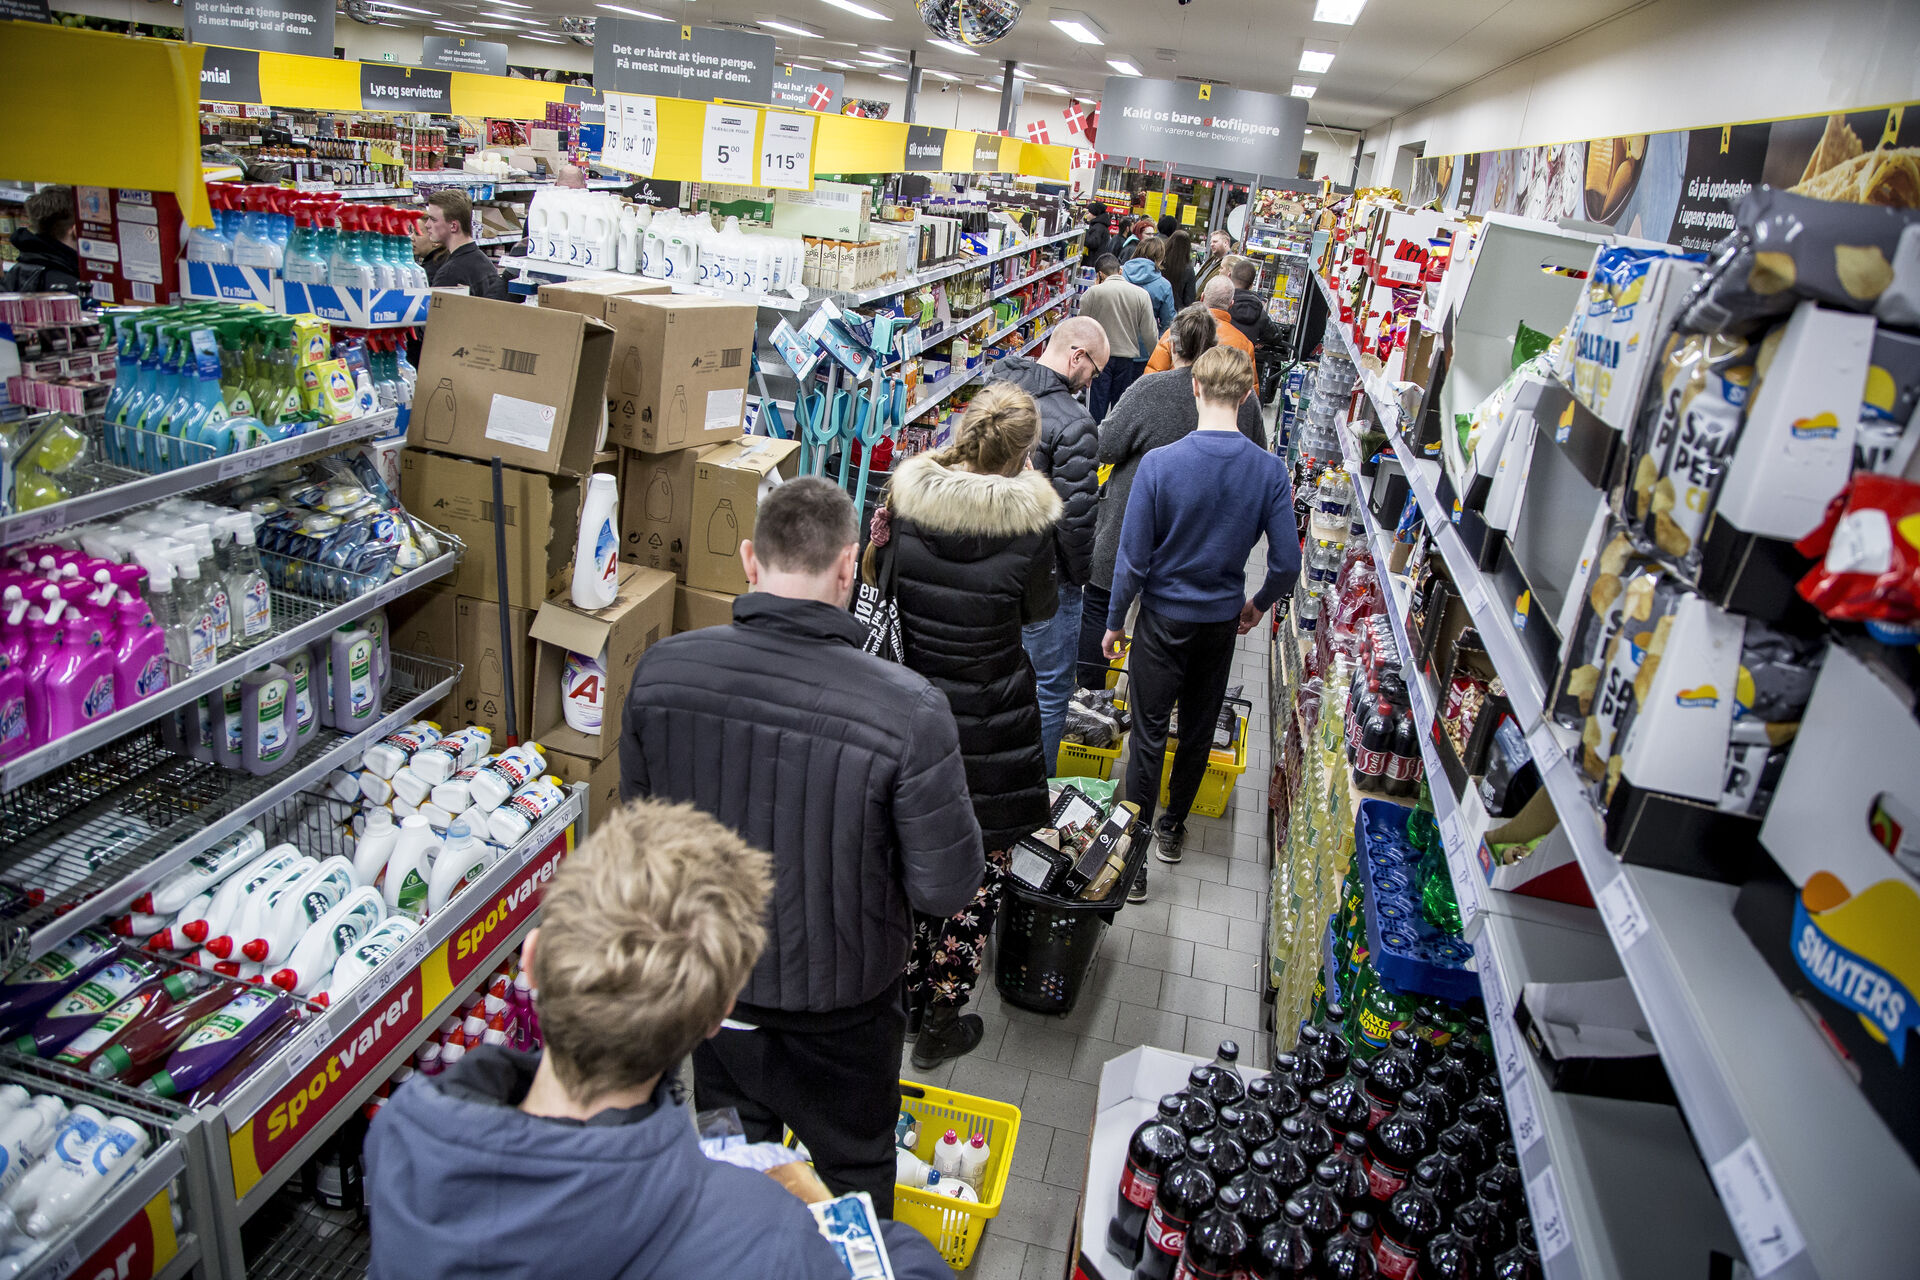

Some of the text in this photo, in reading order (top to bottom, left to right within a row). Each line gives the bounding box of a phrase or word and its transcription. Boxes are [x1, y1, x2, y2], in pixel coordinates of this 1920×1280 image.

[195, 2, 317, 23] Det er hårdt at tjene penge.
[198, 15, 312, 36] Få mest muligt ud af dem.
[612, 43, 756, 72] Det er hårdt at tjene penge.
[617, 58, 751, 83] Få mest muligt ud af dem.
[370, 82, 443, 99] Lys og servietter
[773, 81, 790, 91] skal
[1123, 106, 1280, 138] Kald os bare økoflippere
[607, 131, 617, 149] 75
[1149, 124, 1163, 133] har
[1165, 127, 1195, 138] varerne
[1196, 129, 1210, 139] der
[1211, 132, 1241, 143] beviser
[623, 136, 634, 152] 134
[642, 137, 651, 156] 10
[717, 144, 730, 164] 5
[765, 153, 795, 170] 115
[1687, 176, 1700, 198] Gå
[1697, 176, 1711, 202] på
[1678, 204, 1686, 224] i
[1682, 210, 1706, 229] ugens
[317, 306, 324, 317] 12
[328, 308, 346, 320] 750ml
[374, 311, 380, 321] 12
[383, 311, 397, 322] 750ml
[452, 346, 470, 358] A+
[433, 498, 450, 509] A+
[602, 551, 619, 581] A
[496, 758, 525, 785] DUCK
[512, 795, 543, 819] DUCK
[536, 834, 545, 846] 10
[456, 850, 563, 961] Spotvarer
[414, 943, 425, 957] 20
[378, 974, 390, 990] 20
[1797, 924, 1906, 1032] SMAXTERS
[1363, 1007, 1391, 1030] FAXE
[313, 1033, 326, 1048] 12
[267, 985, 414, 1143] Spotvarer
